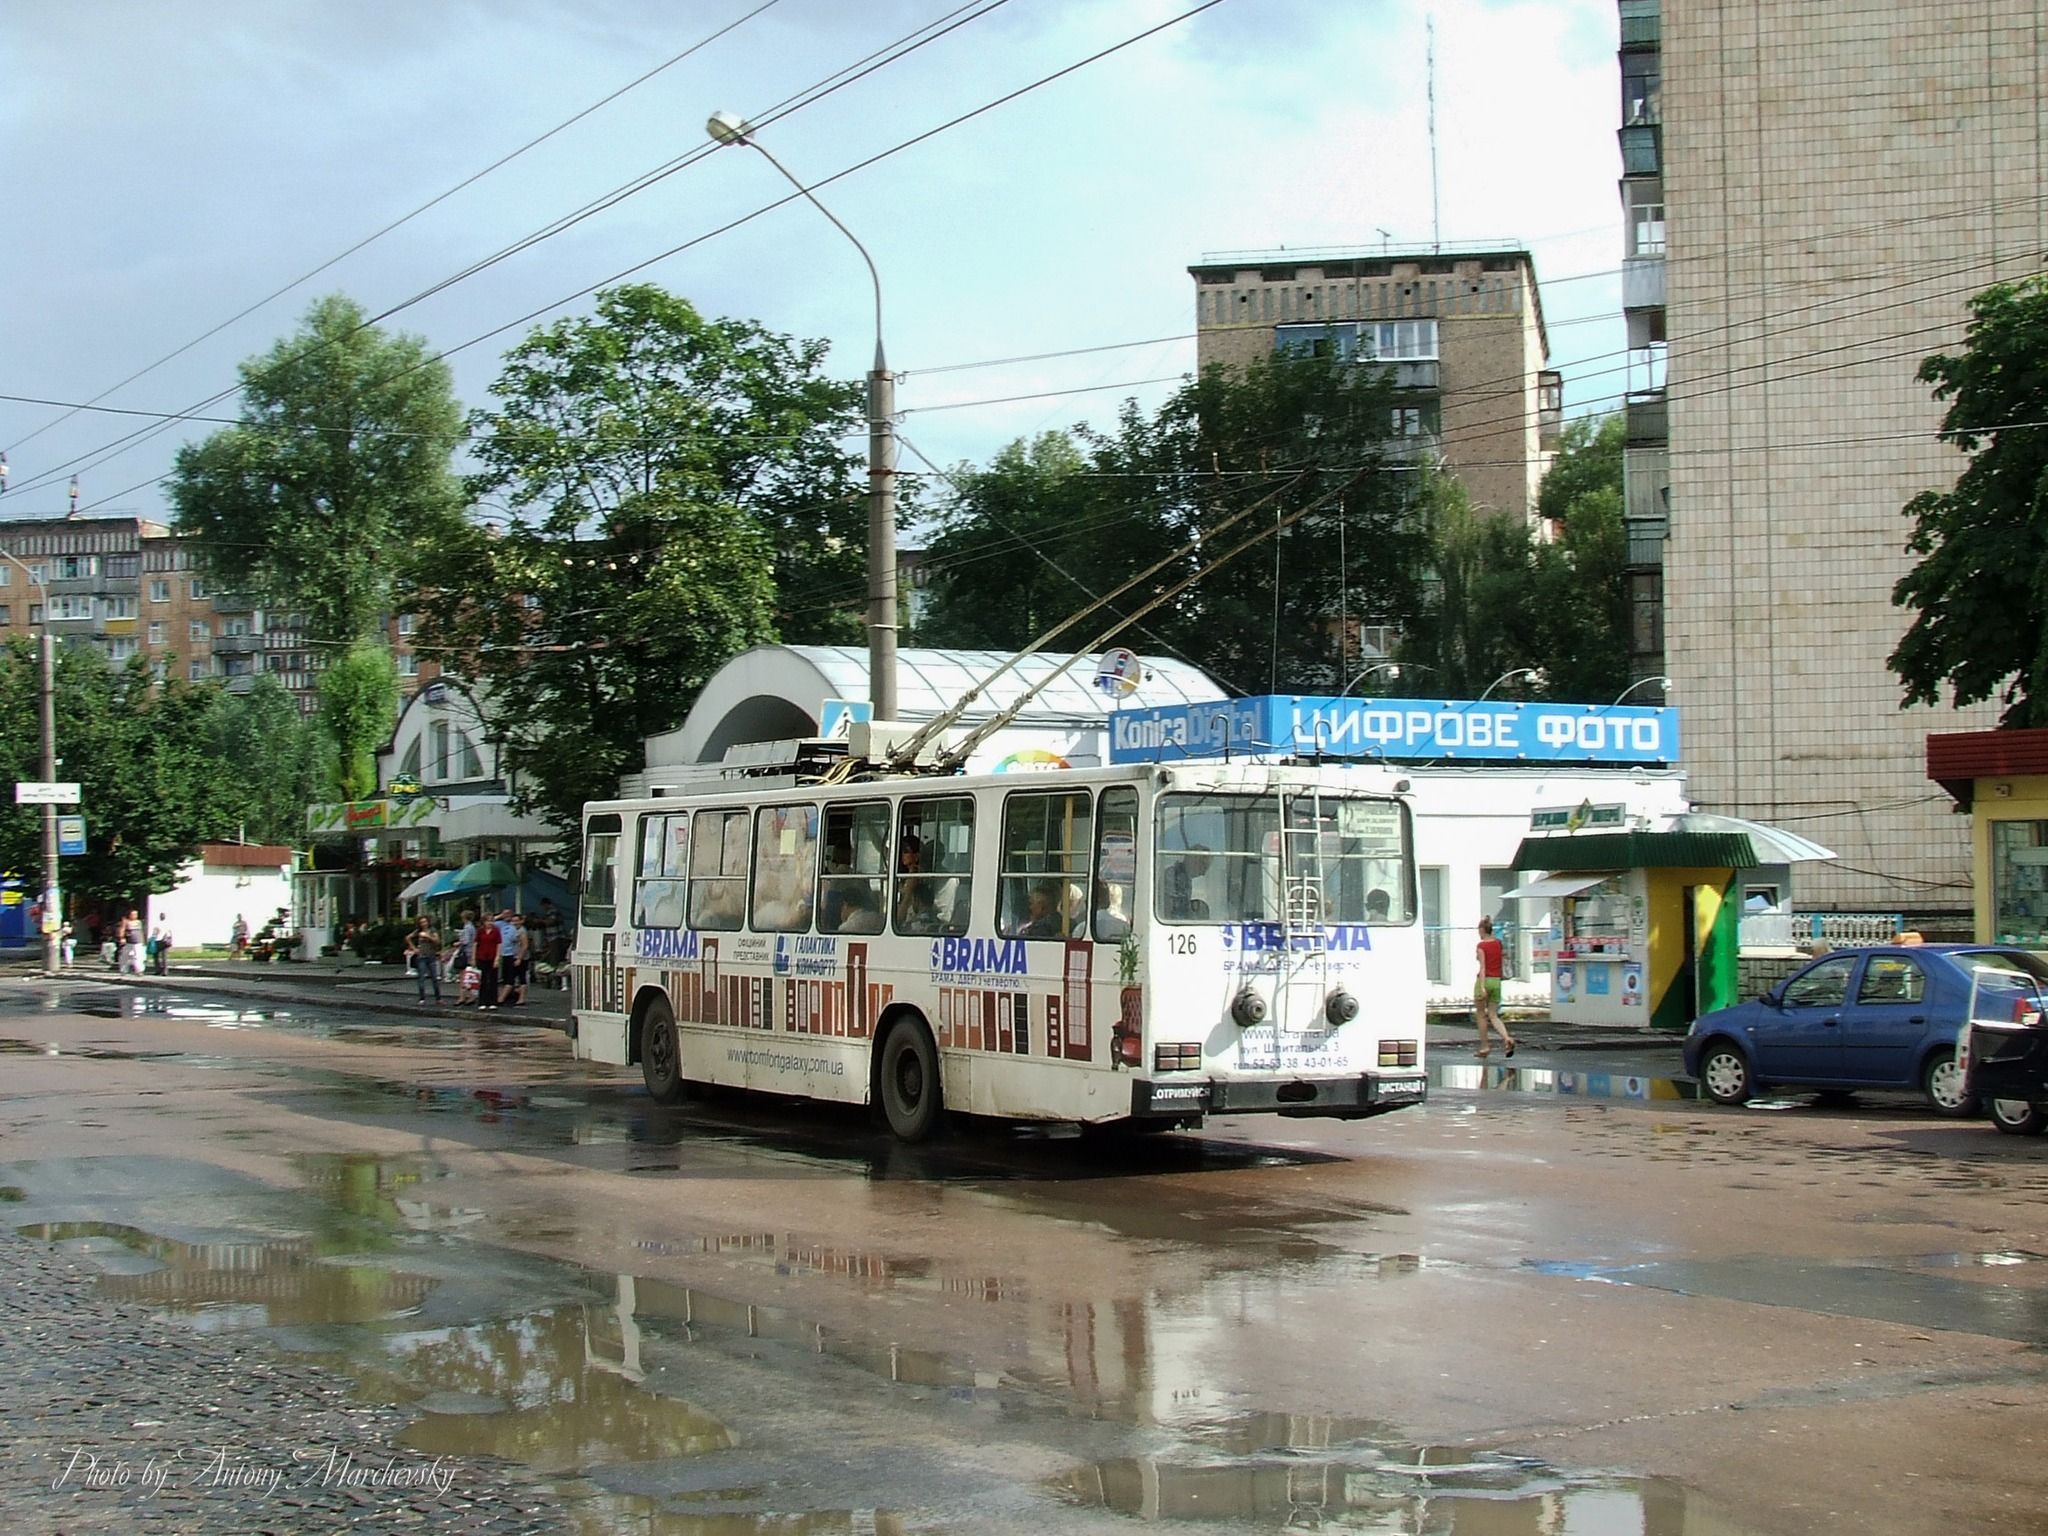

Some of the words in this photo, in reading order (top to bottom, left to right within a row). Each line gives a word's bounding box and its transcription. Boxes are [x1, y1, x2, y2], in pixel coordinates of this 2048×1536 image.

[1291, 708, 1520, 749] ЦИФРОВЕ
[1536, 713, 1660, 750] ФОТО
[621, 930, 632, 948] 126
[642, 928, 699, 959] BRAMA
[795, 936, 838, 955] ГАЛАКТИКА
[1167, 933, 1198, 955] 126
[1240, 920, 1372, 952] BRAMA
[795, 957, 838, 977] КОМФОРТУ
[942, 937, 1028, 975] BRAMA
[726, 1047, 845, 1076] www.comfortgalaxy.com.ua
[1151, 1085, 1211, 1101] ОТРИМУЙСЯ
